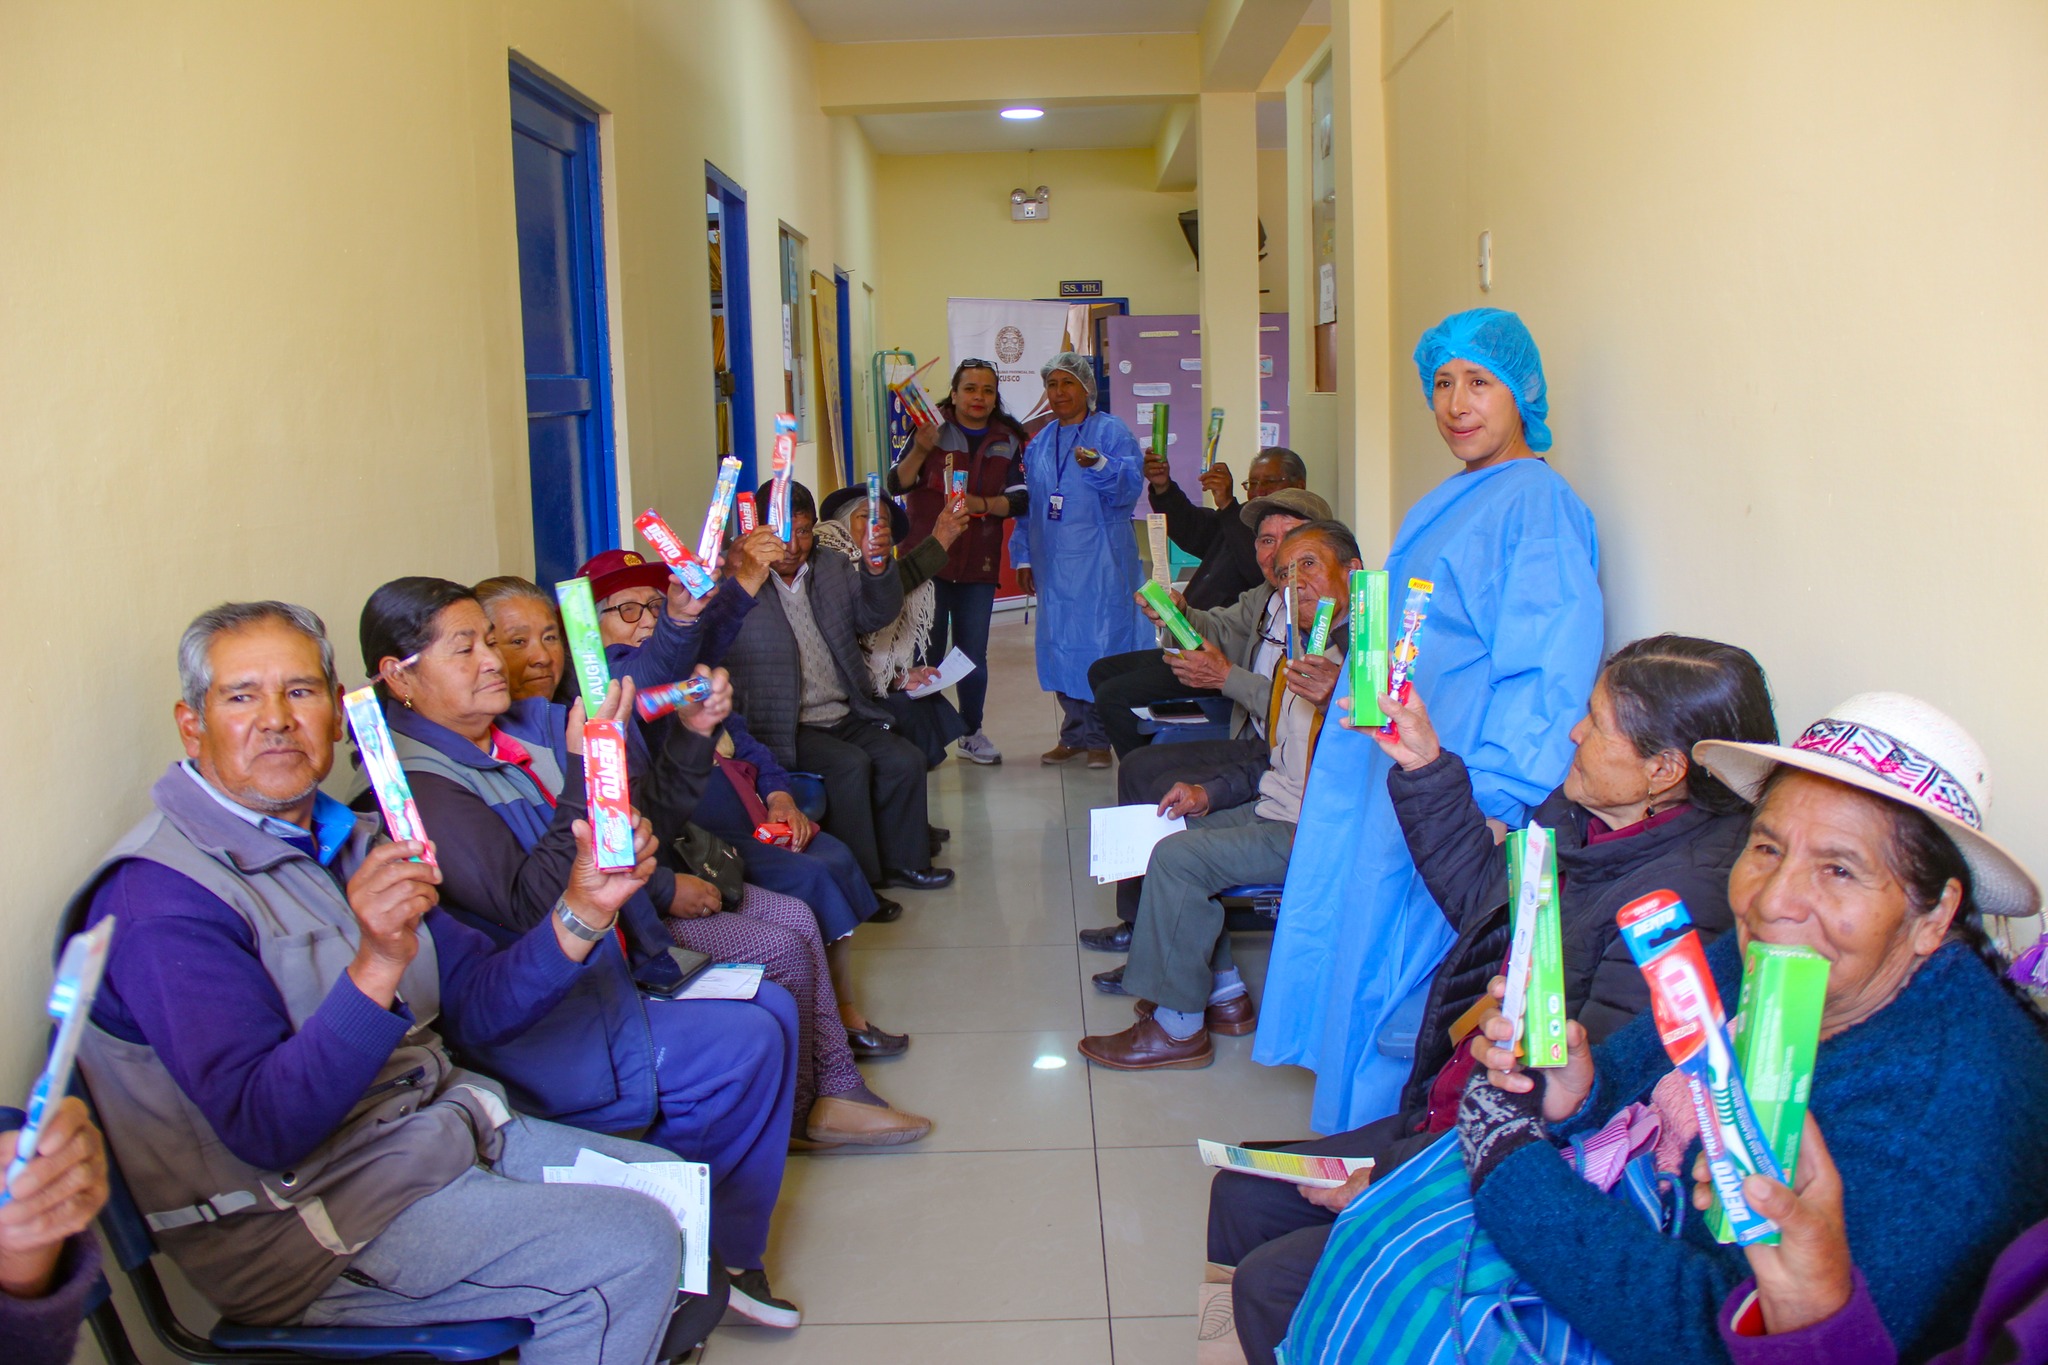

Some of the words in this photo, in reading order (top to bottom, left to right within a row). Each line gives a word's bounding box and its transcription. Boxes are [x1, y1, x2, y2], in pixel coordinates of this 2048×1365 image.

[742, 502, 754, 530] DENTO
[645, 523, 681, 559] DENTO
[581, 653, 605, 706] LAUGH
[597, 737, 621, 801] DENTO
[1633, 908, 1677, 938] DENTO
[1696, 1110, 1720, 1157] PREMIUM
[1711, 1160, 1751, 1224] DENTO
